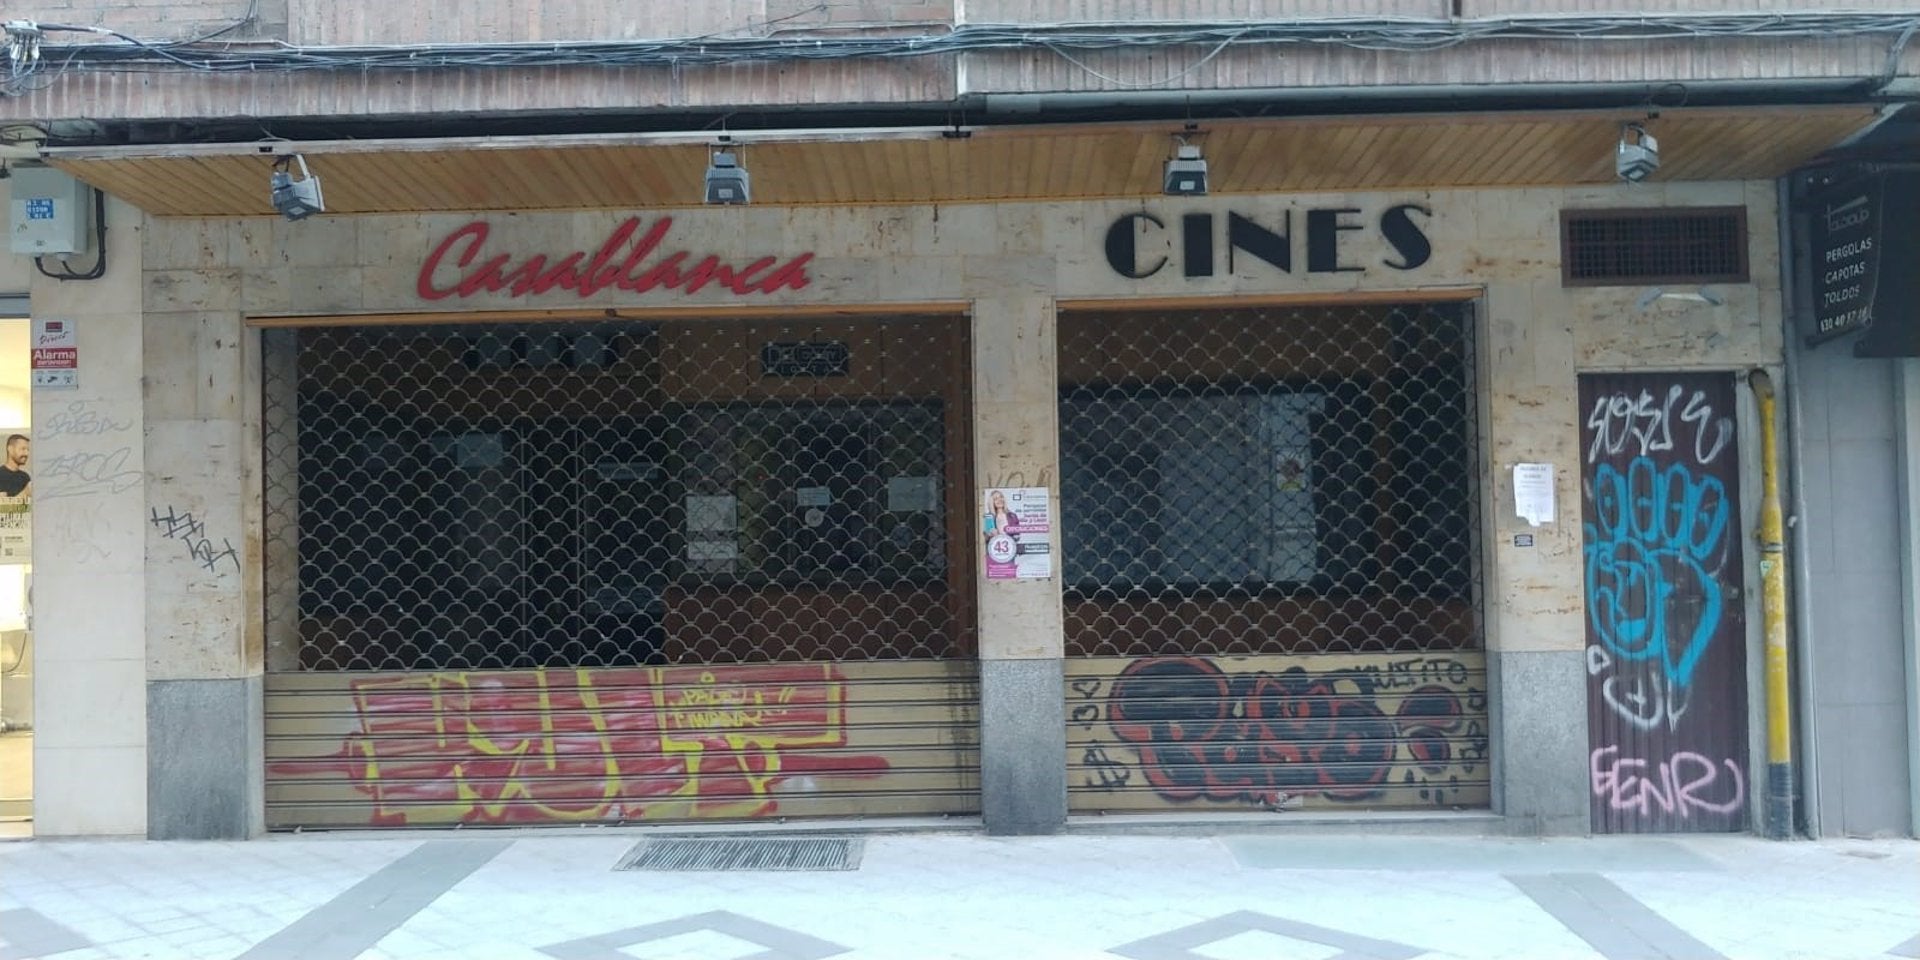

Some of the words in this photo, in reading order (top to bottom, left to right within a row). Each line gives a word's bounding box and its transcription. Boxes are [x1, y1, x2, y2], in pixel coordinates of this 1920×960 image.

[1105, 204, 1432, 279] CINES
[1826, 237, 1872, 263] PERGOLAS
[417, 216, 815, 300] Casablanca
[1825, 261, 1865, 284] CAPOTAS
[1824, 284, 1860, 308] TOLDOS
[35, 349, 76, 360] Alarma
[994, 541, 1009, 553] 43
